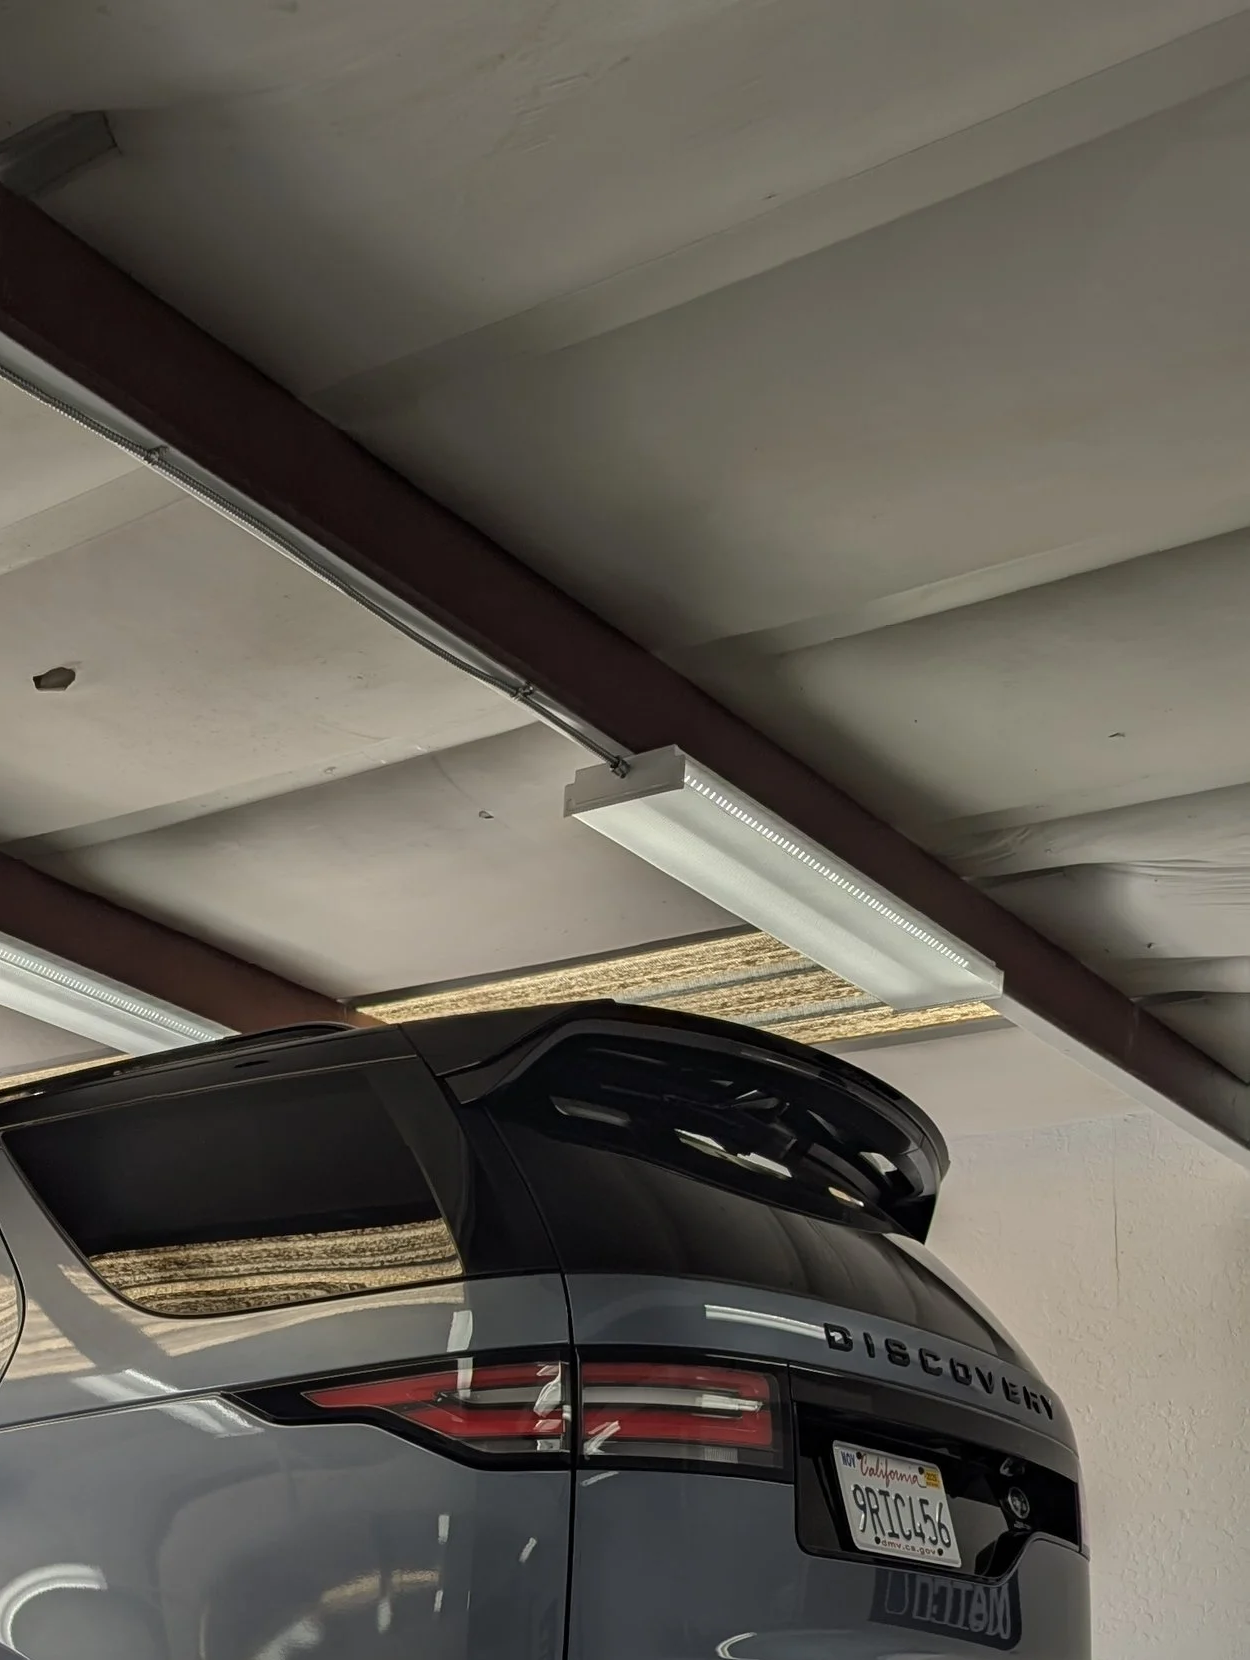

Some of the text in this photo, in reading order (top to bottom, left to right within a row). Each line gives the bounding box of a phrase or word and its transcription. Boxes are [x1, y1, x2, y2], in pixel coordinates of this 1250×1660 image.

[824, 1323, 1053, 1420] DISCOVERY
[859, 1453, 927, 1488] California
[852, 1483, 952, 1548] 9RIC456
[881, 1540, 936, 1555] dmv.ca.gov
